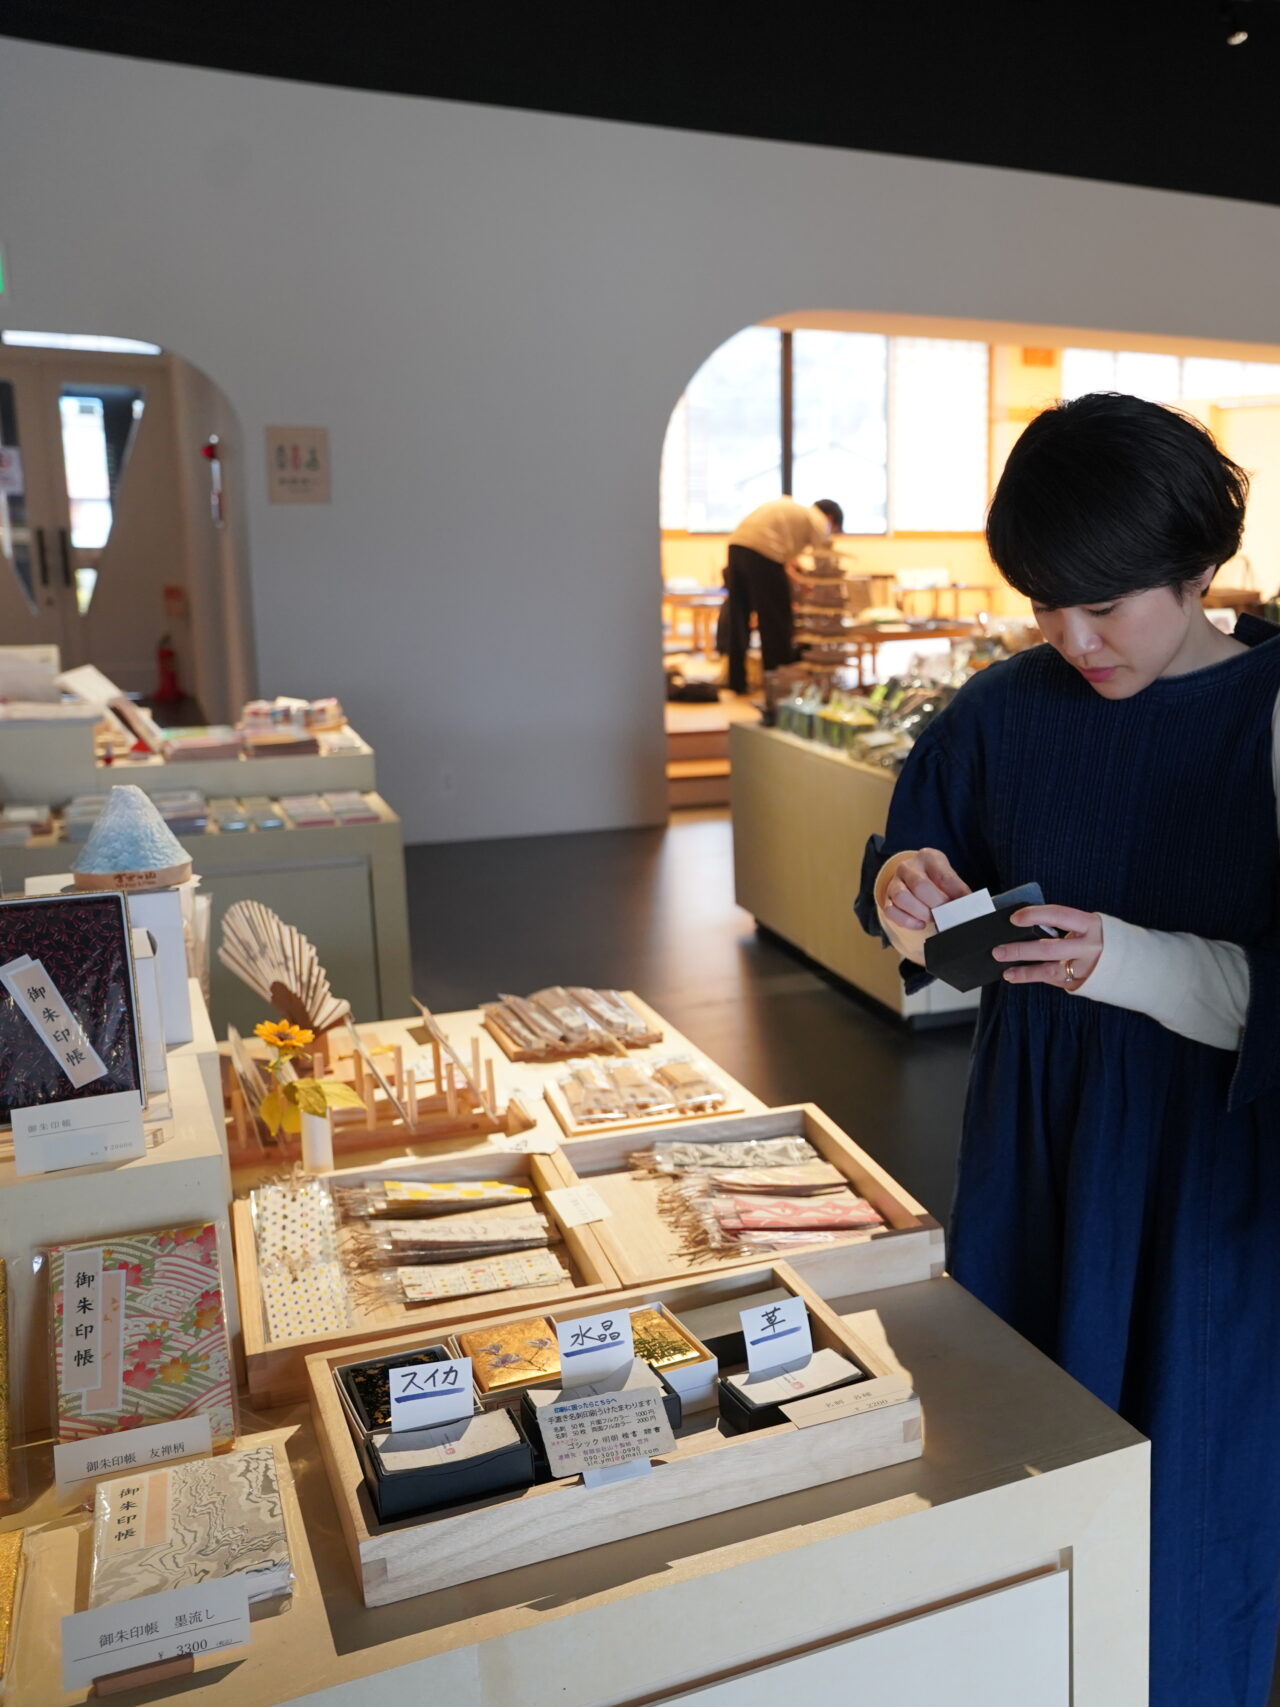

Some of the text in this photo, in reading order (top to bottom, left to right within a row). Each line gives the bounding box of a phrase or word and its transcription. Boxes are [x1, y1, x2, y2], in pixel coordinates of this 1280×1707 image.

[27, 986, 87, 1066] 御朱印帳
[74, 1271, 95, 1367] 御朱印帳
[760, 1306, 786, 1334] 草
[570, 1319, 621, 1348] 水晶
[400, 1365, 459, 1393] スイカ
[567, 1439, 599, 1450] ゴシック
[86, 1452, 137, 1473] 御朱印帳
[114, 1487, 140, 1541] 御朱印帳
[99, 1608, 216, 1648] 御朱印帳 墨流し
[176, 1639, 208, 1657] 3300
